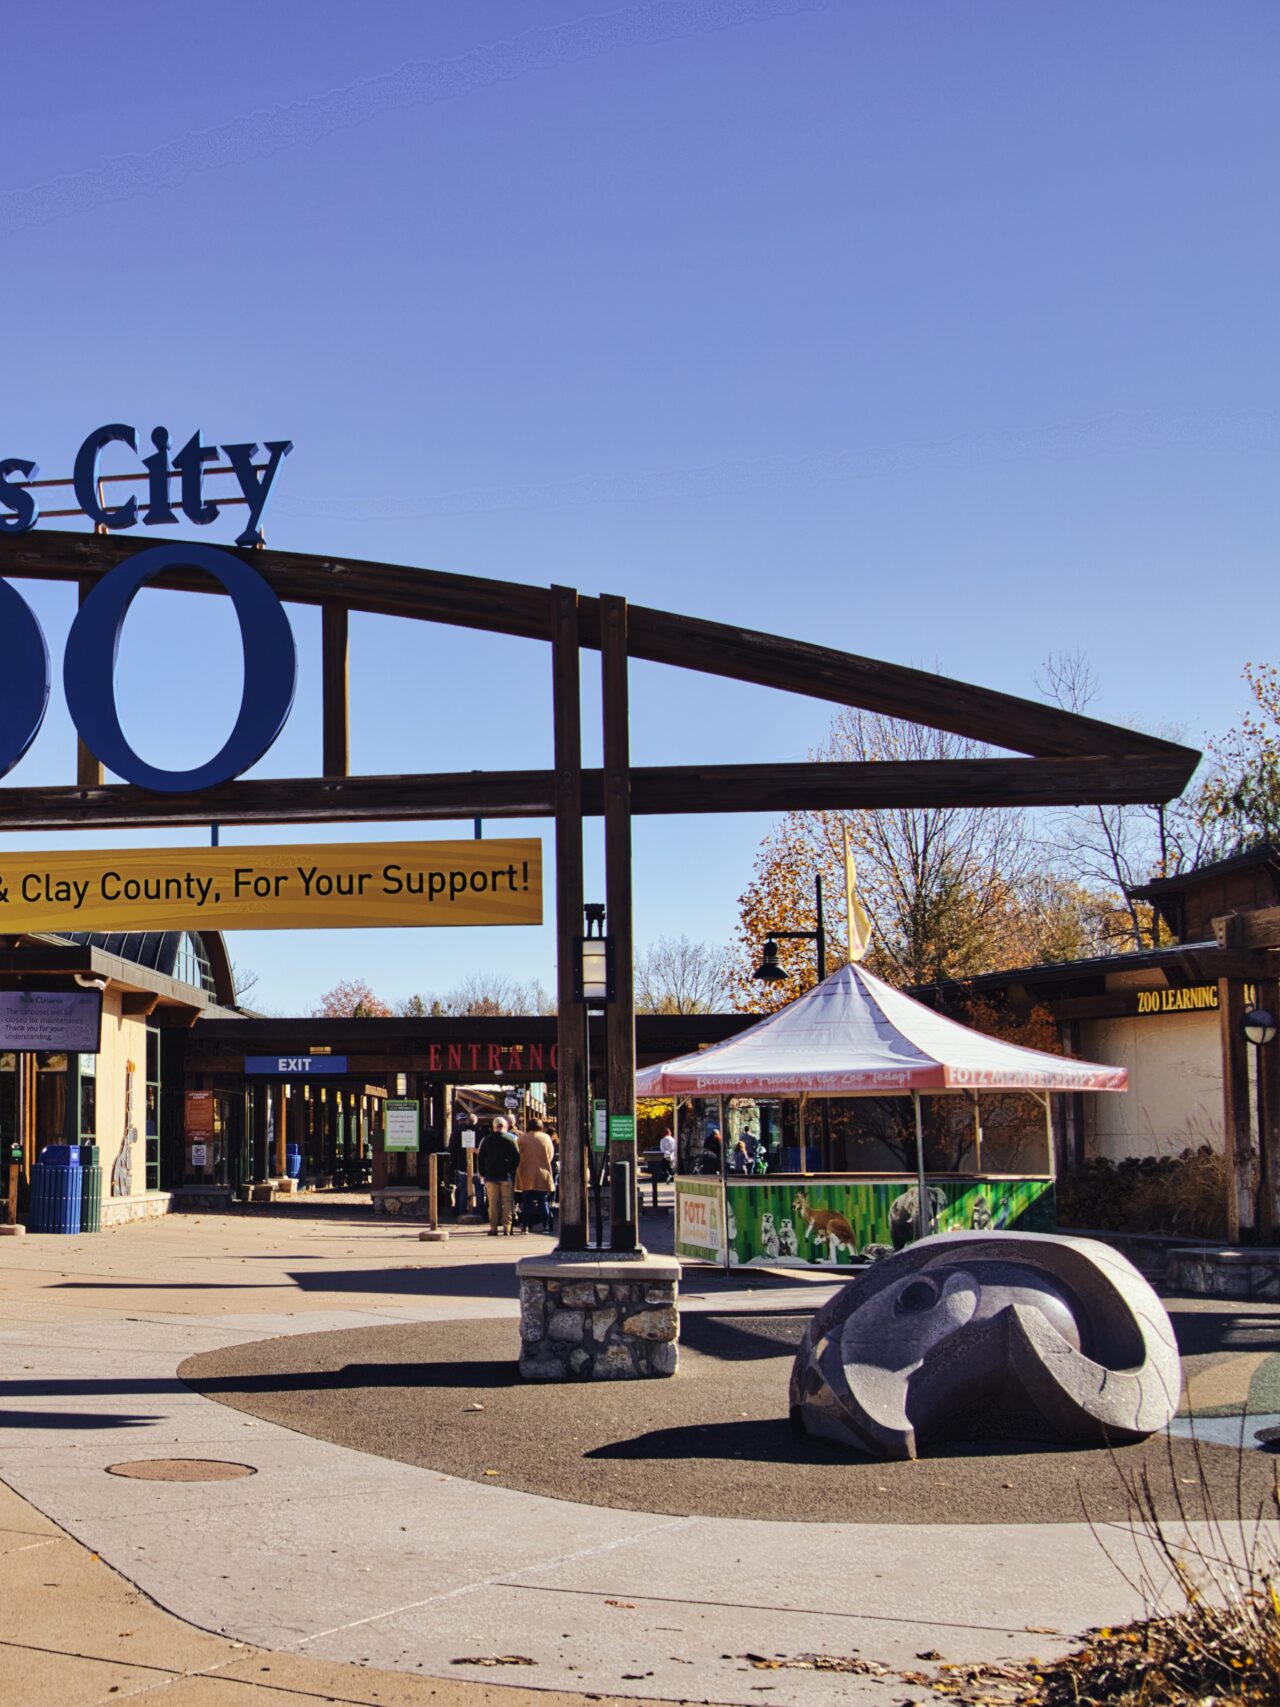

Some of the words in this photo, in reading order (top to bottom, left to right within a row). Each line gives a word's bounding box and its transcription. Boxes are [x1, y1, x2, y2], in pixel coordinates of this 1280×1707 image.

[74, 423, 294, 547] City
[22, 873, 90, 909] Clay
[100, 871, 220, 906] County,
[235, 868, 289, 897] For
[297, 866, 372, 896] Your
[382, 861, 529, 902] Support!
[1137, 991, 1160, 1013] ZOO
[1162, 986, 1218, 1011] LEARNING
[278, 1058, 312, 1071] EXIT
[428, 1043, 559, 1072] ENTRANC
[697, 1076, 743, 1088] Become
[800, 1074, 814, 1086] of
[840, 1072, 865, 1084] Zoo
[949, 1066, 987, 1083] FOTZ
[684, 1200, 706, 1226] FOTZ
